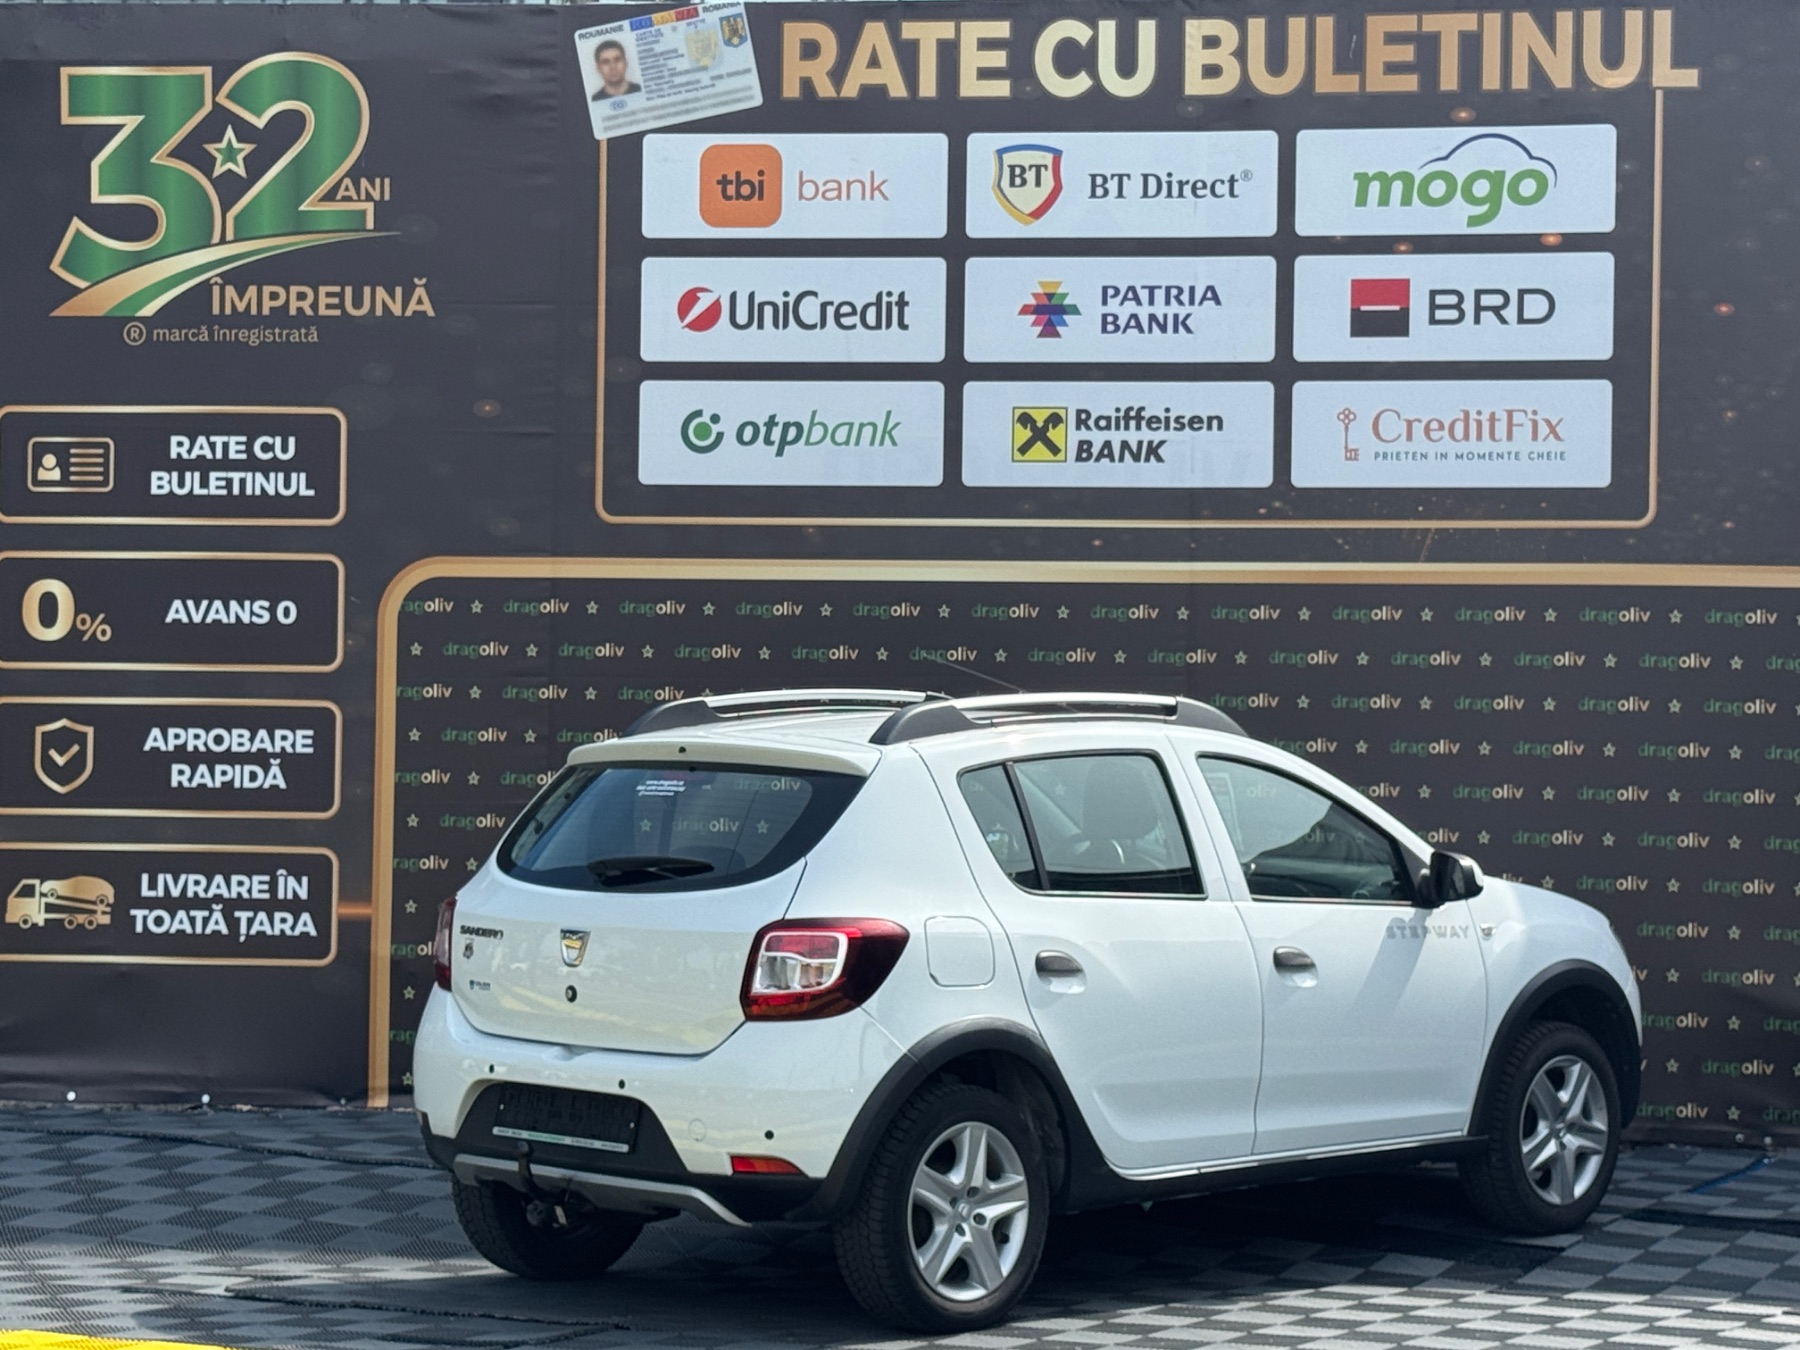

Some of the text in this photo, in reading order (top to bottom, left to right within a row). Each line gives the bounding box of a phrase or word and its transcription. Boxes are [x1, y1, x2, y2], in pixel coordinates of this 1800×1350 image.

[578, 24, 625, 41] ROUMANIE
[780, 20, 1011, 98] RATE
[1033, 18, 1157, 98] CU
[1184, 9, 1699, 97] BULETINUL
[49, 51, 374, 290] 32
[1007, 164, 1049, 189] BT
[335, 177, 391, 201] ANI
[716, 169, 889, 202] tbi bank
[1087, 173, 1131, 200] BT
[1353, 168, 1550, 229] mogo
[211, 277, 436, 318] ÎMPREUNĂ
[1101, 285, 1222, 307] PATRIA
[1428, 288, 1556, 326] BRD
[729, 290, 910, 331] UniCredit
[153, 325, 210, 342] marcă
[214, 324, 319, 346] înregistrată
[1101, 313, 1194, 335] BANK
[1075, 406, 1224, 432] Raiffeisen
[1371, 408, 1565, 443] CreditFix
[735, 409, 902, 458] otpbank
[169, 435, 296, 460] RATE CU
[1075, 440, 1168, 464] BANK
[1374, 451, 1567, 462] PRIETEN IN MOMENTE CHEIE
[150, 471, 315, 497] BULETINUL
[22, 578, 112, 642] 0%
[165, 600, 297, 625] AVANS 0
[403, 598, 1778, 628] agoliv dragoliv dragoliv dragoliv dragoliv dragoliv dragoliv dragoliv dragoliv dragoliv dragoliv dragoliv
[442, 641, 509, 659] dragoliv
[558, 642, 625, 659] dragoliv
[674, 643, 742, 661] dragoliv
[791, 645, 859, 663] dragoliv
[909, 646, 977, 664] dragoliv
[1027, 647, 1097, 665] dragoliv
[1147, 648, 1217, 666] dragoliv
[1269, 650, 1339, 667] dragoliv
[1390, 650, 1462, 668] dragoliv
[1514, 651, 1586, 670] dragoliv
[1639, 653, 1711, 671] dragoliv
[396, 683, 685, 704] ragoliv dragoliv dragoliv
[1331, 694, 1402, 712] dragoliv
[1454, 695, 1525, 713] dragoliv
[1578, 696, 1650, 715] dragoliv
[1703, 698, 1777, 717] dragoliv
[143, 727, 314, 754] APROBARE
[441, 727, 508, 745] dragoliv
[1389, 739, 1460, 757] dragoliv
[1513, 740, 1584, 758] dragoliv
[1638, 742, 1710, 760] dragoliv
[170, 758, 287, 790] RAPIDĂ
[395, 769, 556, 787] ragoliv dragol
[1452, 784, 1525, 802] dragoliv
[1577, 785, 1649, 804] dragoliv
[1703, 787, 1776, 806] dragoliv
[439, 814, 506, 831] dragoliv
[1512, 830, 1584, 848] dragoliv
[1637, 832, 1710, 851] dragoliv
[393, 855, 449, 872] ragoliv
[140, 869, 309, 900] LIVRARE ÎN
[1577, 875, 1776, 897] dragoliv dragoliv
[129, 903, 318, 943] TOATĂ ȚARA
[1386, 925, 1470, 940] STEPWAY
[1637, 922, 1709, 941] dragoliv
[391, 941, 432, 958] ragol
[1701, 969, 1775, 987] dragoliv
[1701, 1059, 1775, 1077] dragoliv
